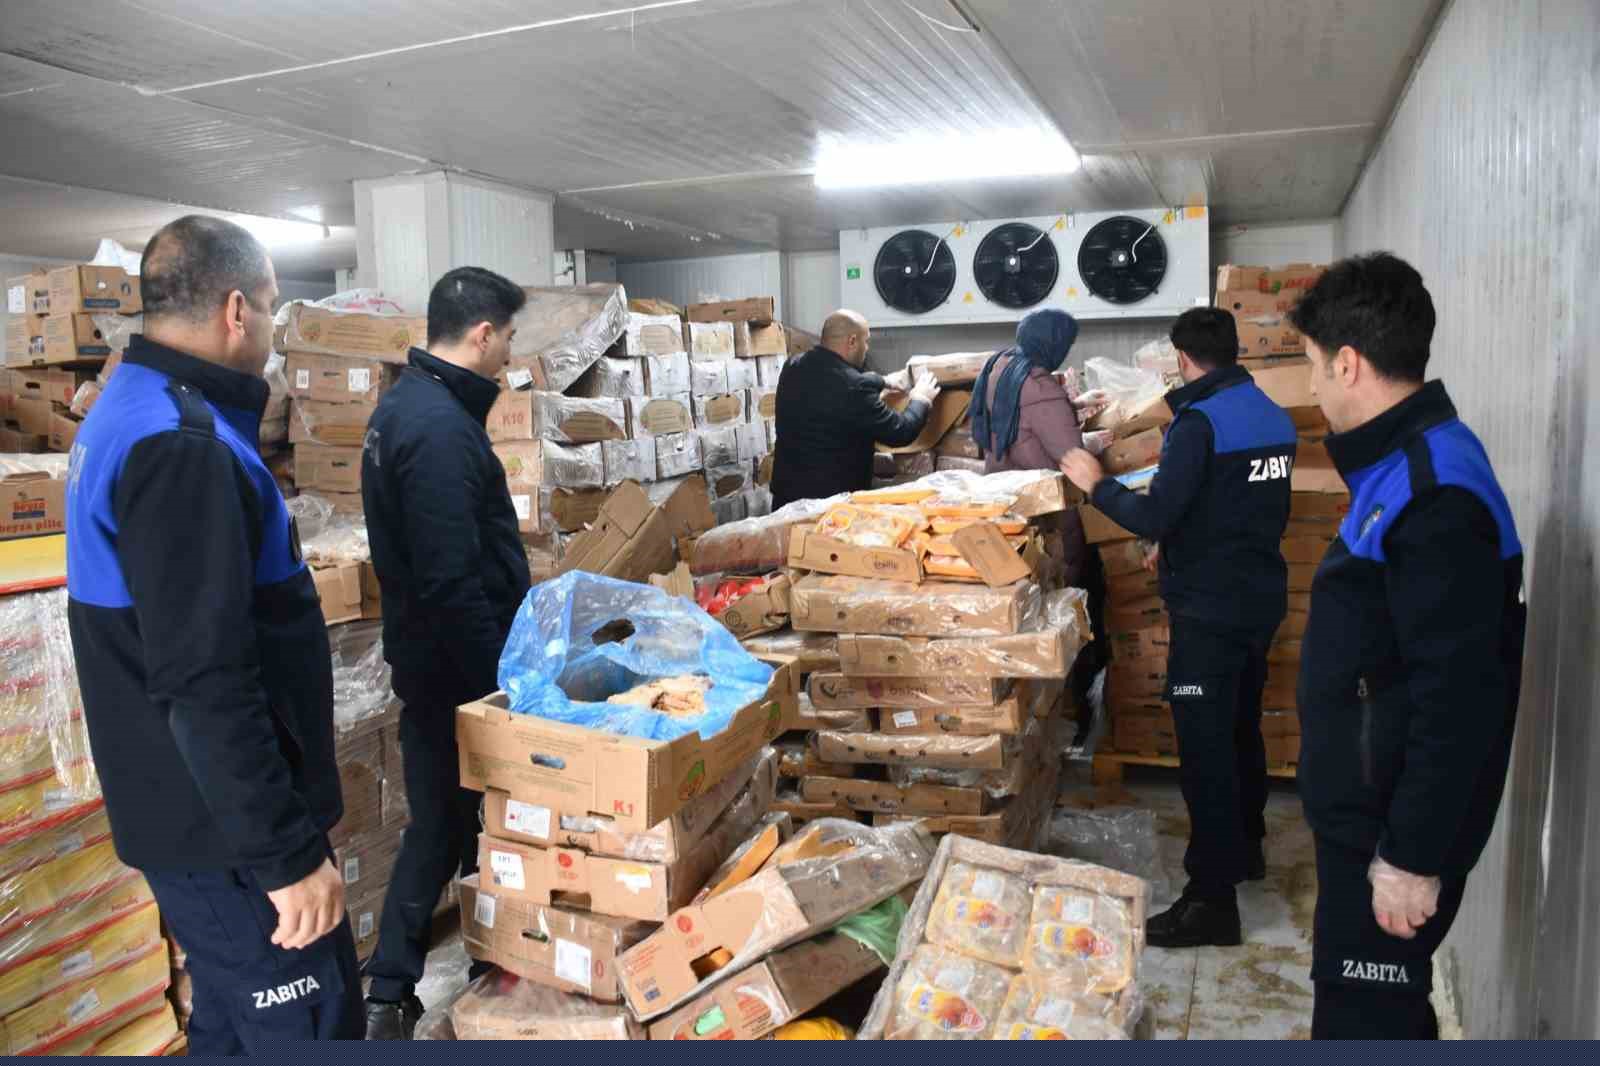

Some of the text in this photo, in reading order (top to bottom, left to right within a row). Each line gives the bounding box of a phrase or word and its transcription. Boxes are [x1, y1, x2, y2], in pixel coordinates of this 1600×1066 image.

[1247, 455, 1292, 482] ZABI
[1172, 685, 1203, 696] ZABITA
[1342, 959, 1409, 983] ZABITA
[251, 975, 320, 1009] ZABITA
